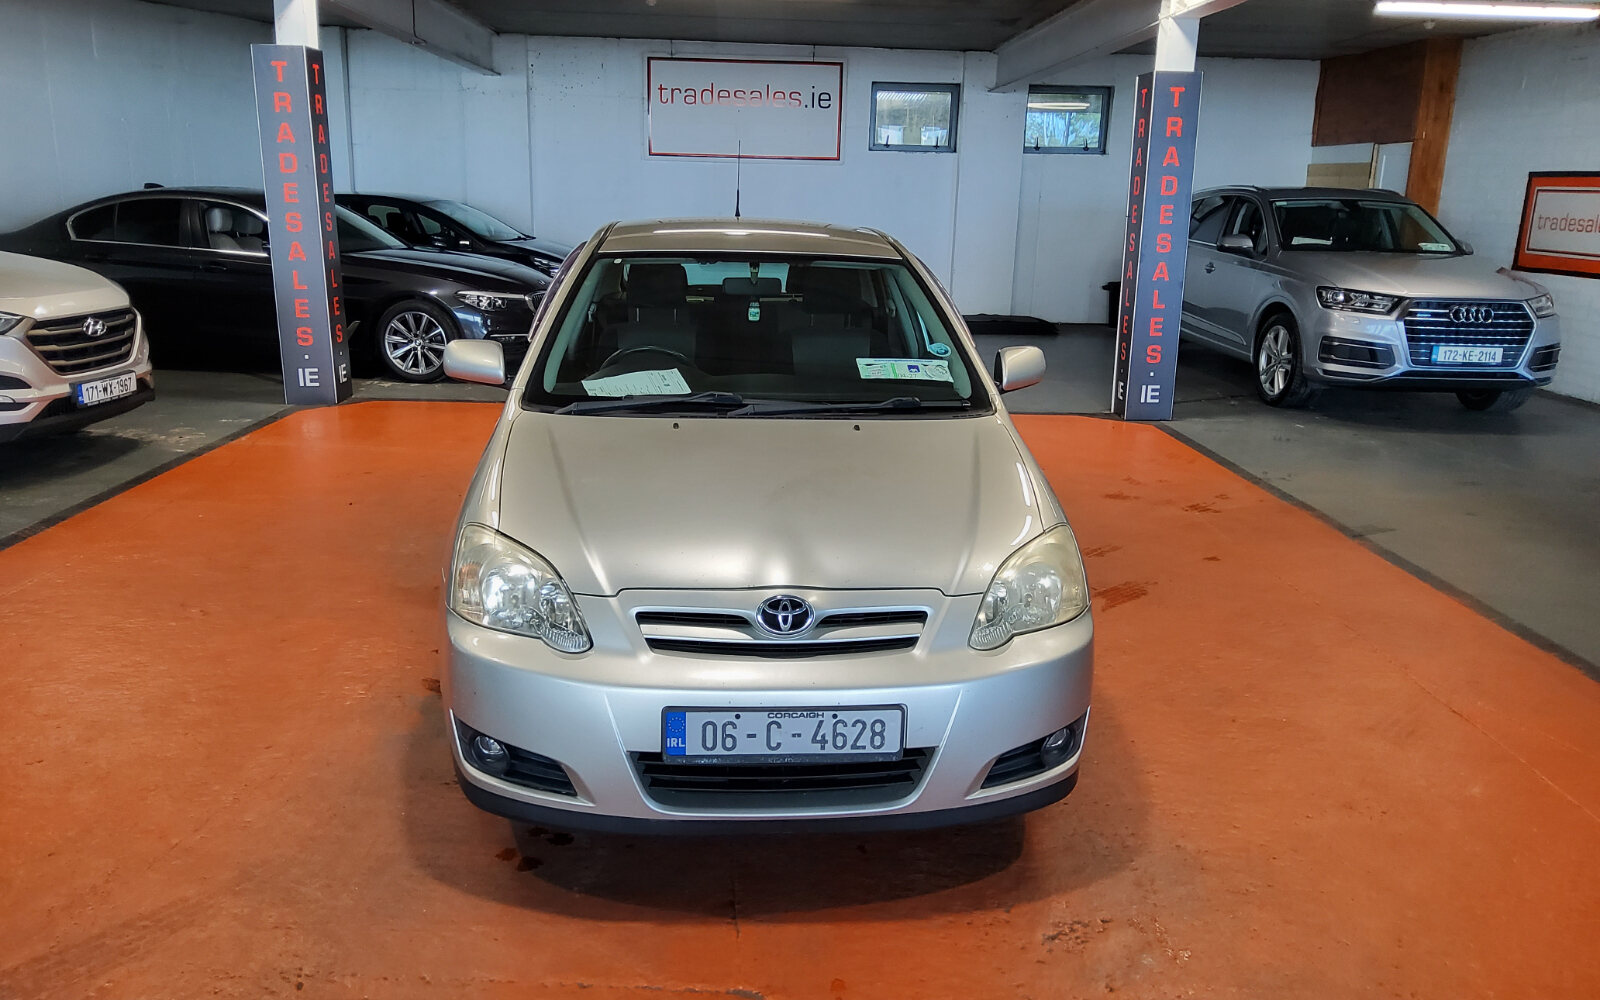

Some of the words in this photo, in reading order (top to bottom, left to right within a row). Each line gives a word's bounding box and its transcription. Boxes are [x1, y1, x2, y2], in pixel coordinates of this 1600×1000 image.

[657, 82, 832, 109] tradesales.ie
[1443, 349, 1497, 362] 172-KE-2114
[85, 377, 132, 401] 171-WX-1967
[666, 737, 686, 748] IRL
